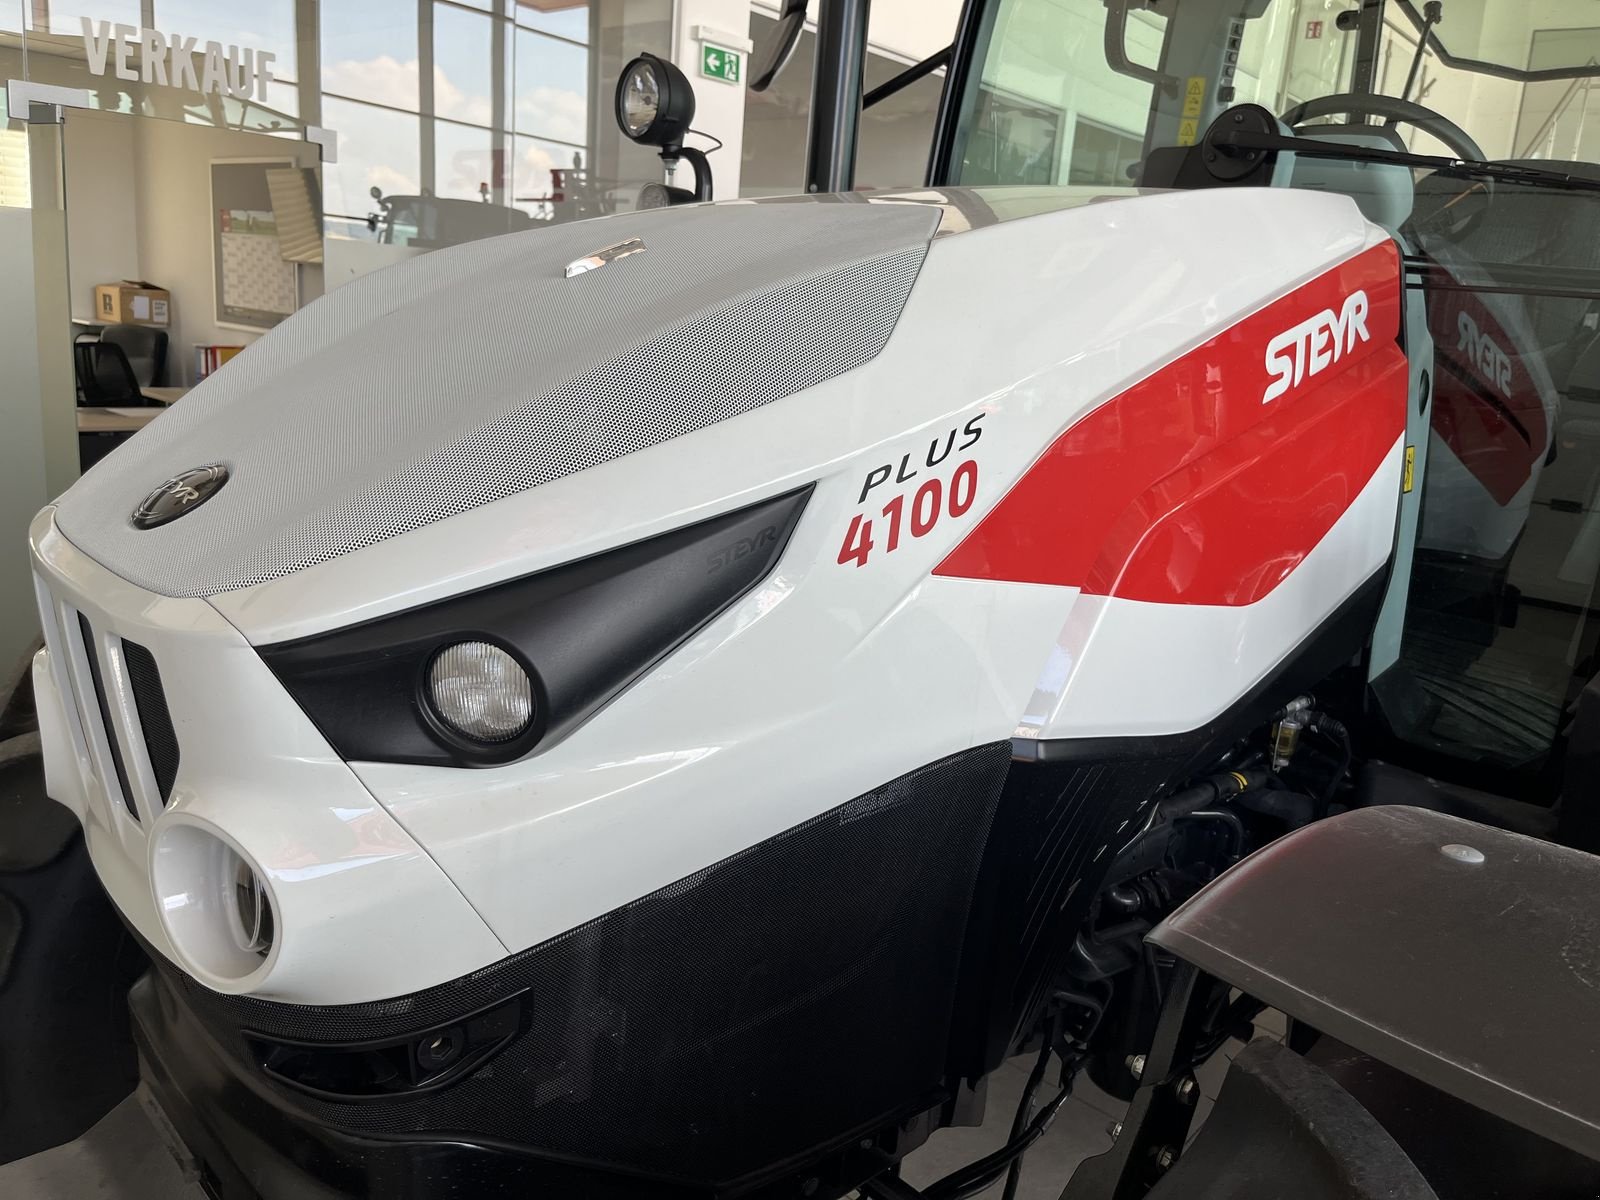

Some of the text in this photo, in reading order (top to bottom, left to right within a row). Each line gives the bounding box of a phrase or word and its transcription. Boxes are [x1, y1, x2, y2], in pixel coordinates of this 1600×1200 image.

[80, 16, 276, 103] VERKAUF
[1262, 289, 1371, 405] STEYR
[857, 412, 986, 504] PLUS
[706, 525, 777, 575] STEYR
[837, 459, 978, 568] 4100
